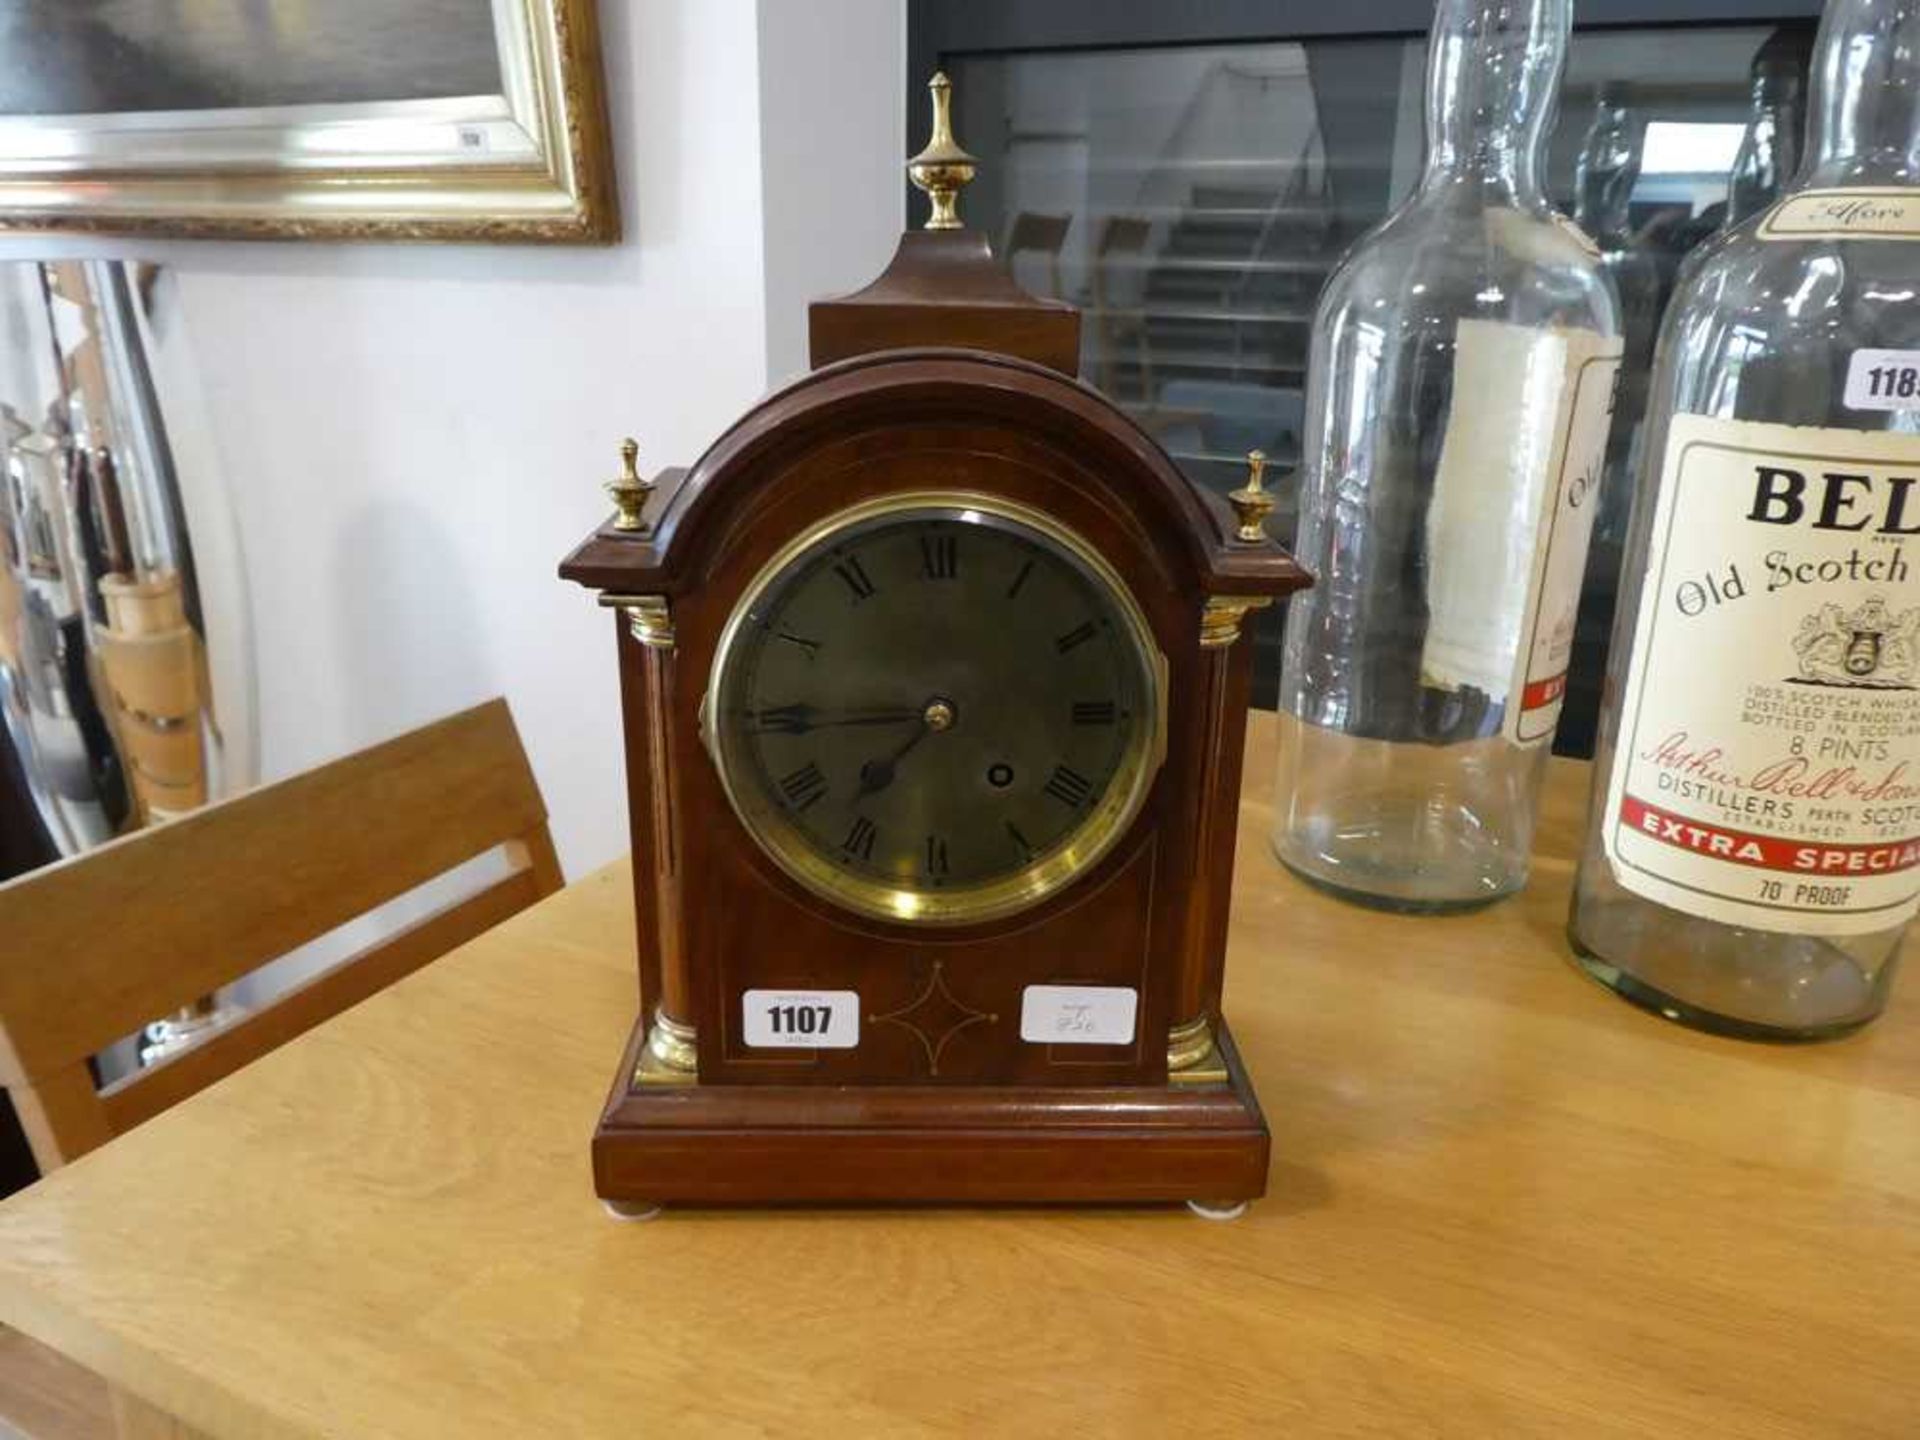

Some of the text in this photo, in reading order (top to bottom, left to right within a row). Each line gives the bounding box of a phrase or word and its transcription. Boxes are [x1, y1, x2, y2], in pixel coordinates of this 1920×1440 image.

[1869, 367, 1920, 398] 118
[1676, 548, 1909, 617] Old Scotch
[1791, 691, 1861, 708] SCOTCH
[1741, 711, 1817, 733] BOTTLED
[1828, 723, 1847, 736] IN
[1790, 735, 1890, 761] 8 PINTS
[1658, 772, 1794, 820] DISTILLERS
[1808, 808, 1852, 822] PERTH
[1642, 811, 1920, 871] EXTRA SPECIA
[1795, 884, 1851, 906] PROOF
[768, 1006, 832, 1034] 1107
